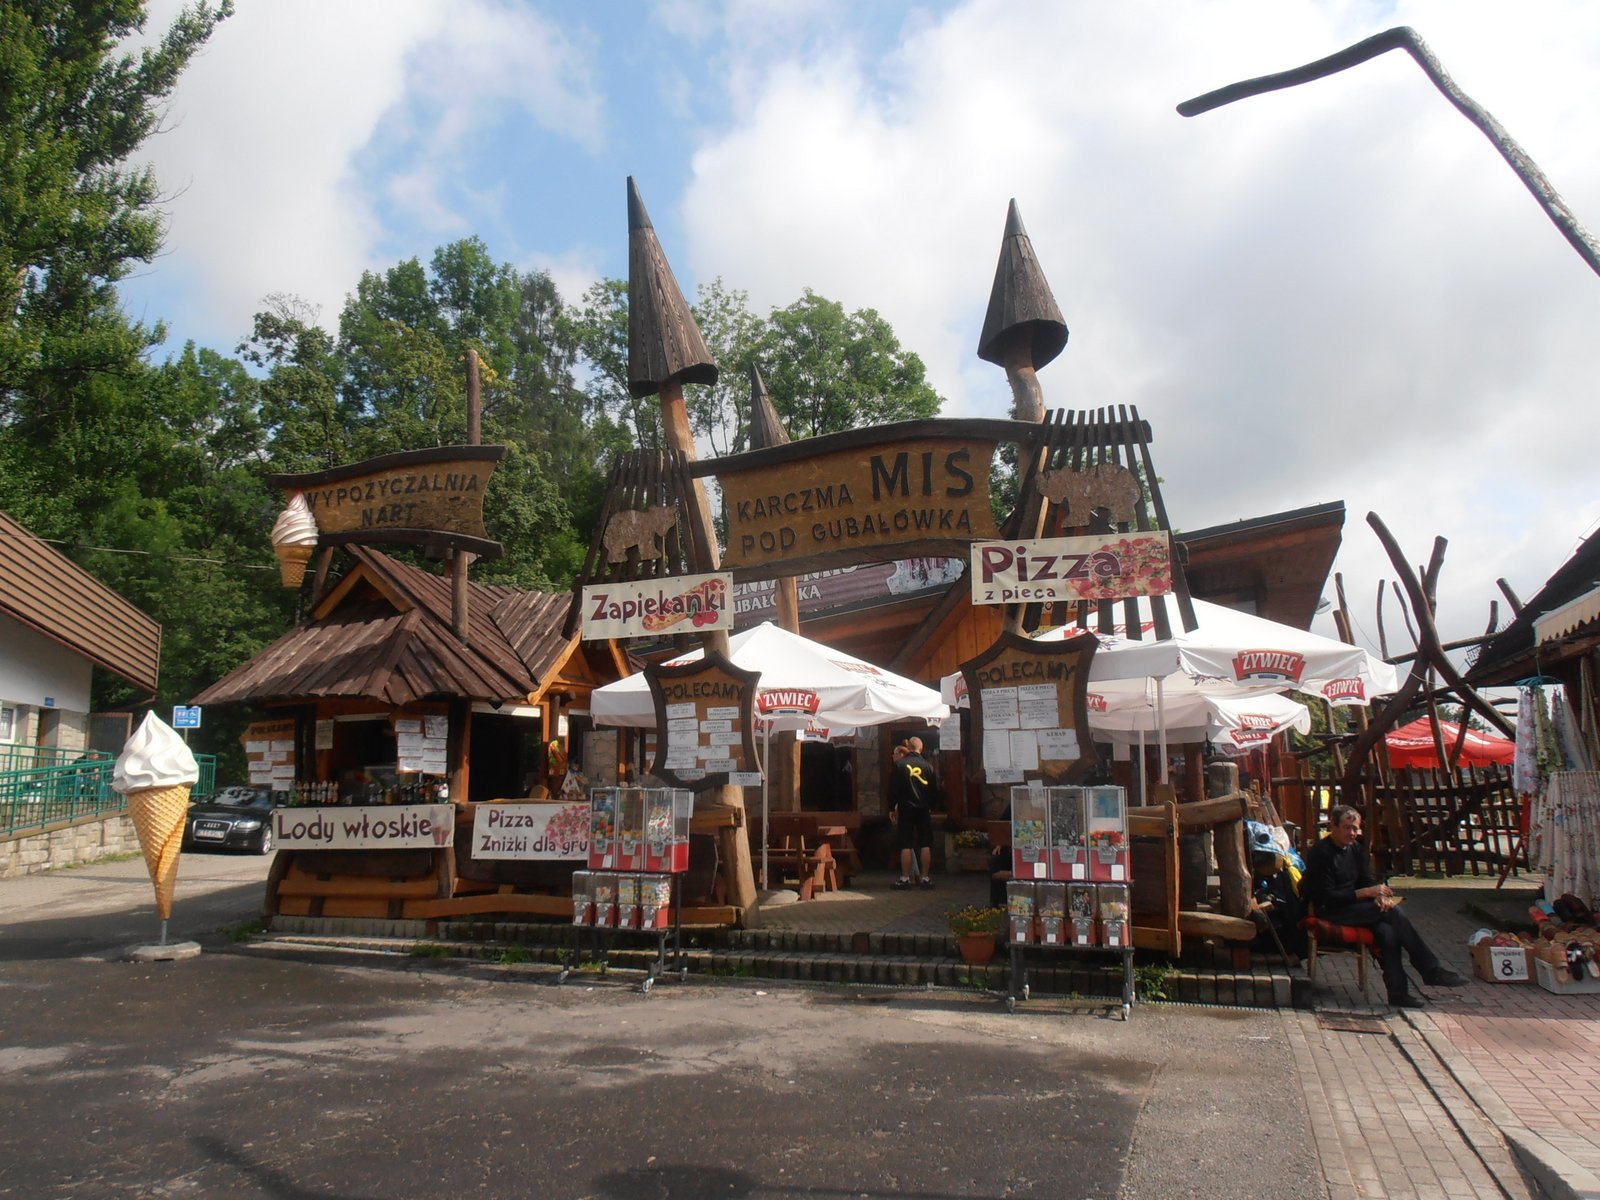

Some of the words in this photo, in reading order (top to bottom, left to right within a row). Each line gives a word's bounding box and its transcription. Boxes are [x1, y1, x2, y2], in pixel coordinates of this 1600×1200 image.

[304, 474, 478, 510] WYPOŻYCZALNIA
[737, 483, 853, 523] KARCZMA
[362, 502, 417, 527] NART
[741, 526, 796, 557] POD
[812, 507, 972, 542] GUBAŁÓWKĄ
[982, 545, 1121, 583] Pizza
[590, 584, 726, 624] Zapiekanki
[985, 591, 993, 600] z
[1002, 586, 1056, 601] pieca
[1242, 651, 1298, 672] ŻYWIEC
[978, 661, 1076, 689] POLECAMY
[664, 681, 745, 699] POLECAMY
[764, 691, 813, 708] ŻYWIEC
[278, 813, 334, 843] Lody
[343, 812, 432, 840] włoskie
[488, 809, 534, 828] Pizza
[480, 835, 527, 852] Zniżki
[533, 835, 556, 852] dla
[562, 840, 588, 855] gru
[1501, 959, 1514, 977] 8
